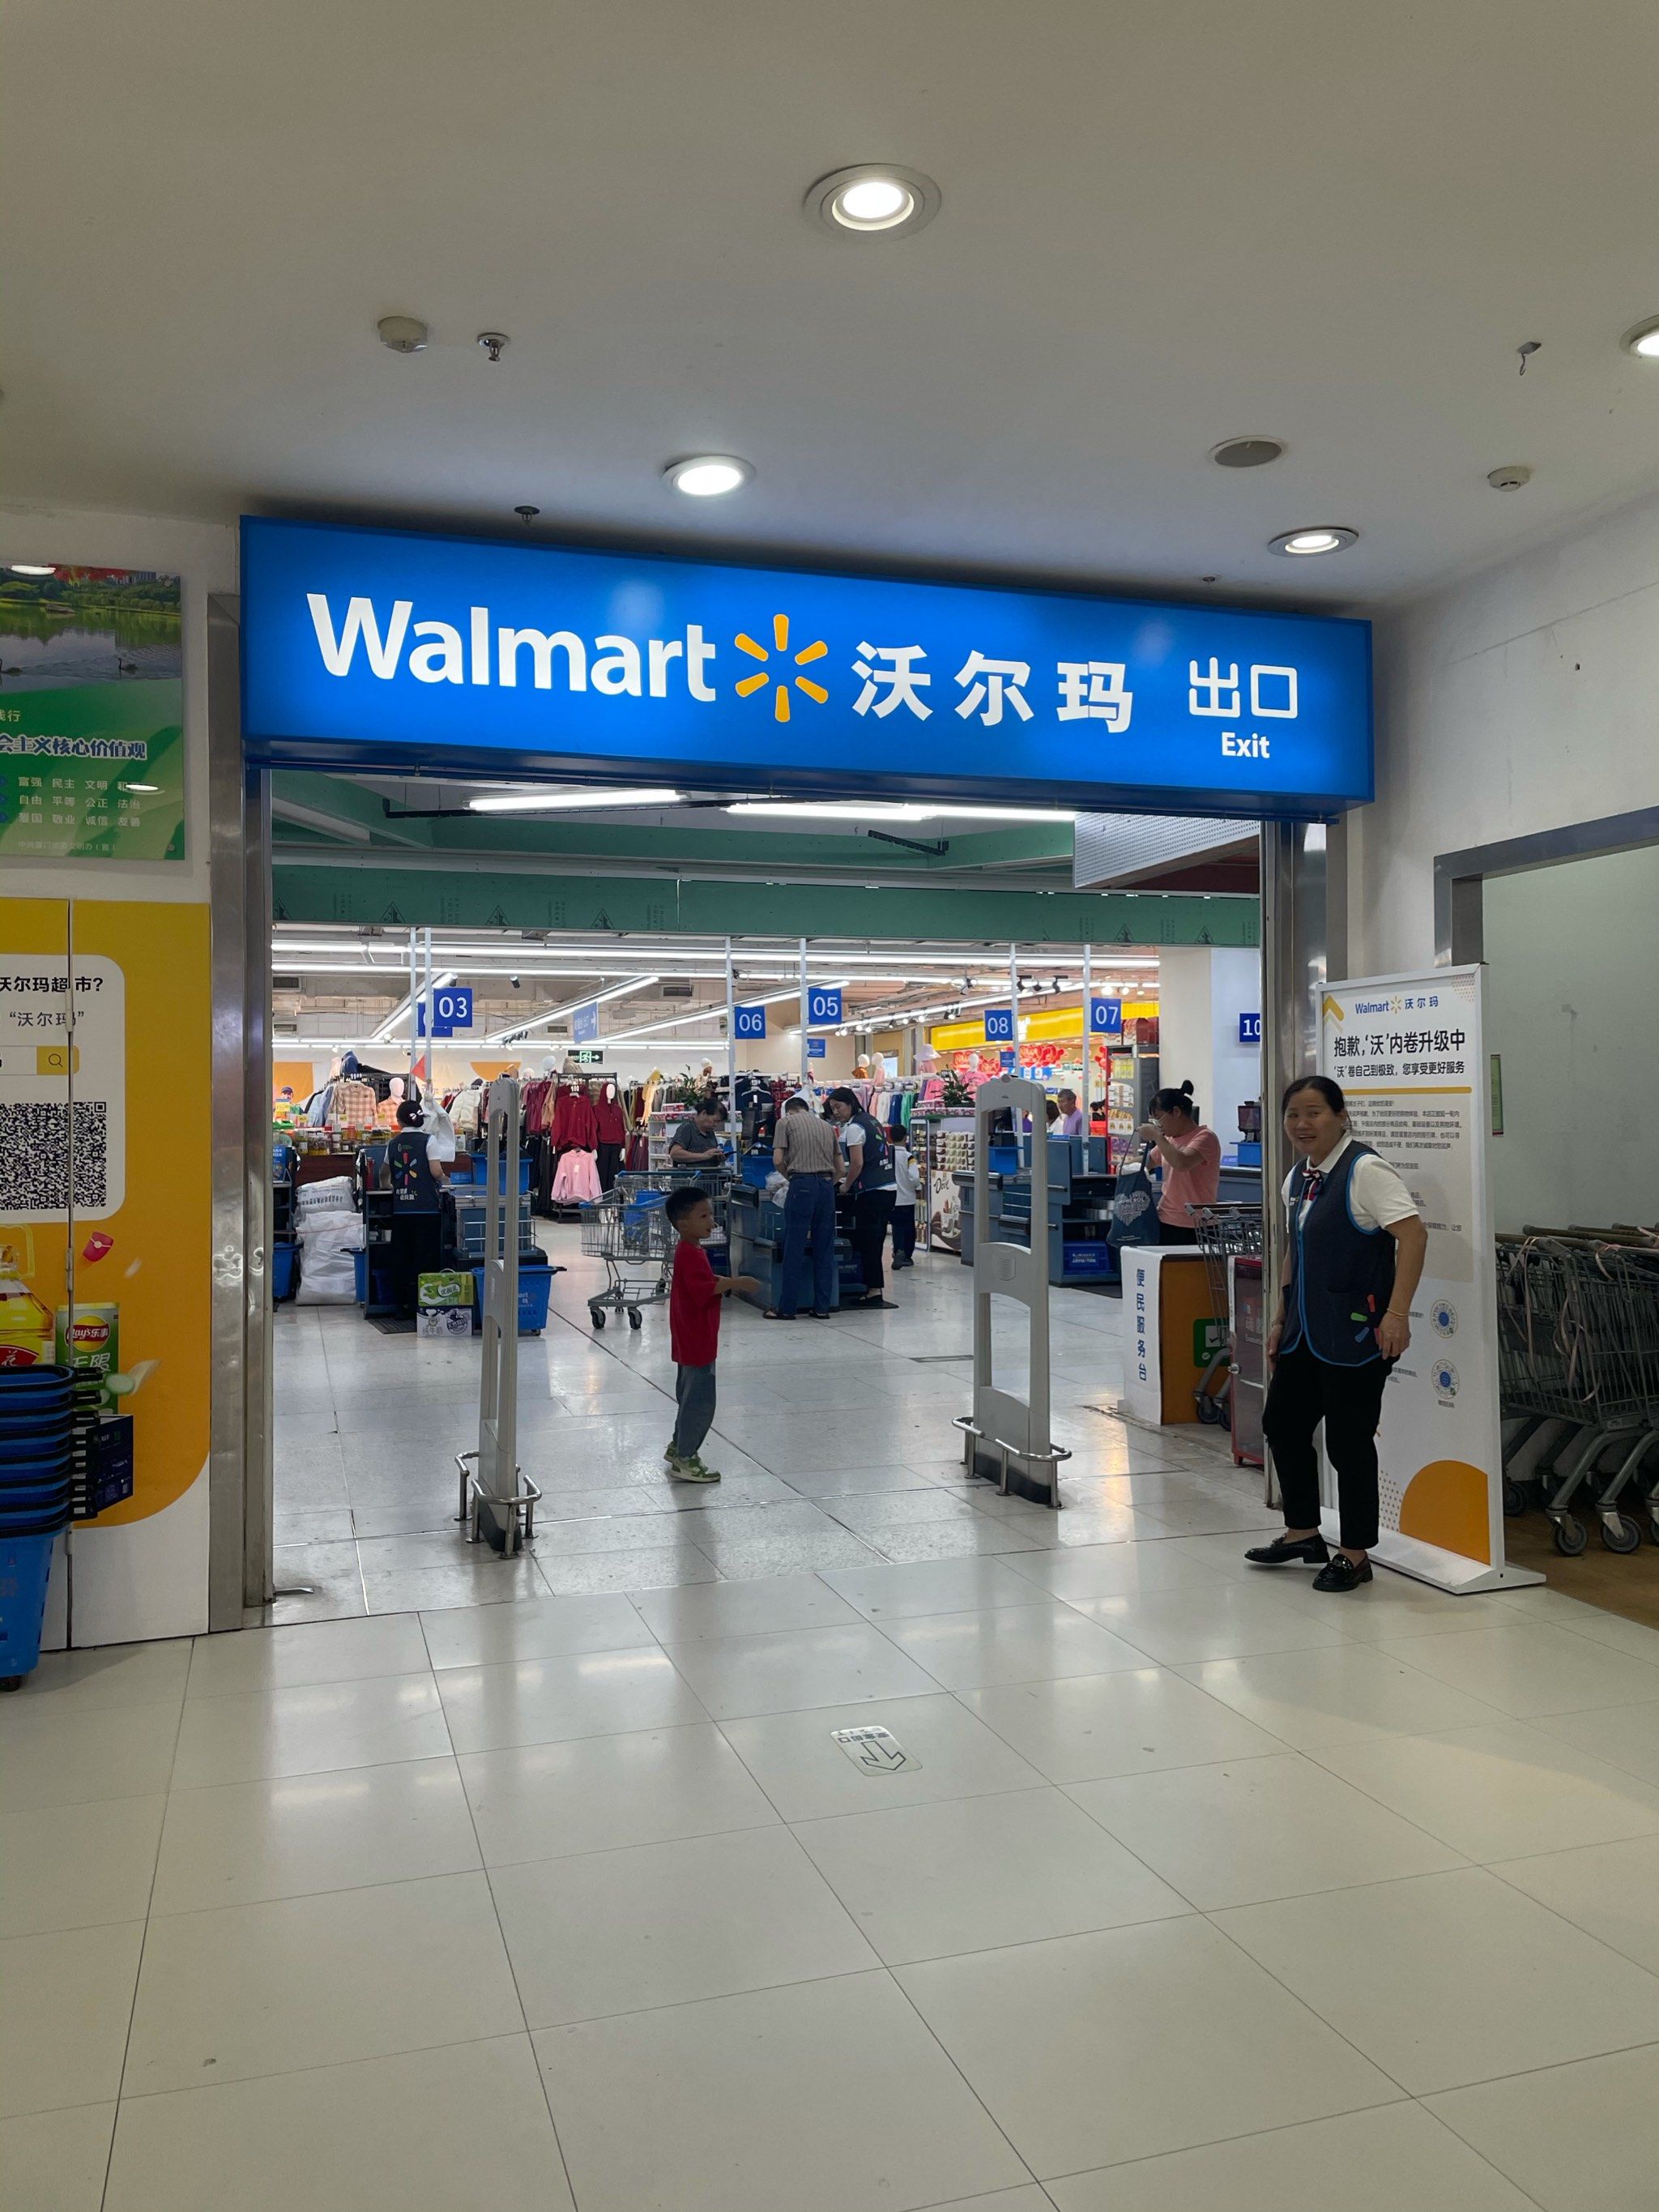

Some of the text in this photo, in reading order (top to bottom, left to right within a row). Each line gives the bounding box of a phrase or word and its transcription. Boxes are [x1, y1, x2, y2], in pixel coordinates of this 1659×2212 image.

[305, 592, 716, 702] Walmart
[851, 640, 1133, 733] 沃尔玛
[1188, 656, 1299, 720] 出口
[1221, 731, 1271, 758] Exit
[18, 776, 42, 788] 富强
[52, 778, 75, 790] 民主
[85, 779, 108, 791] 文明
[19, 795, 140, 810] 自由 平等 公正 法治
[52, 813, 75, 825] 敬业
[85, 815, 109, 826] 诚信
[117, 817, 140, 828] 友善
[438, 996, 467, 1018] 03
[812, 996, 839, 1017] 05
[1355, 1000, 1390, 1014] Walmart
[1405, 995, 1439, 1010] 沃尔玛
[738, 1013, 763, 1032] 06
[987, 1016, 1009, 1035] 08
[1094, 1005, 1119, 1026] 07
[1243, 1018, 1261, 1036] 10
[1136, 1267, 1148, 1382] 便民服务台
